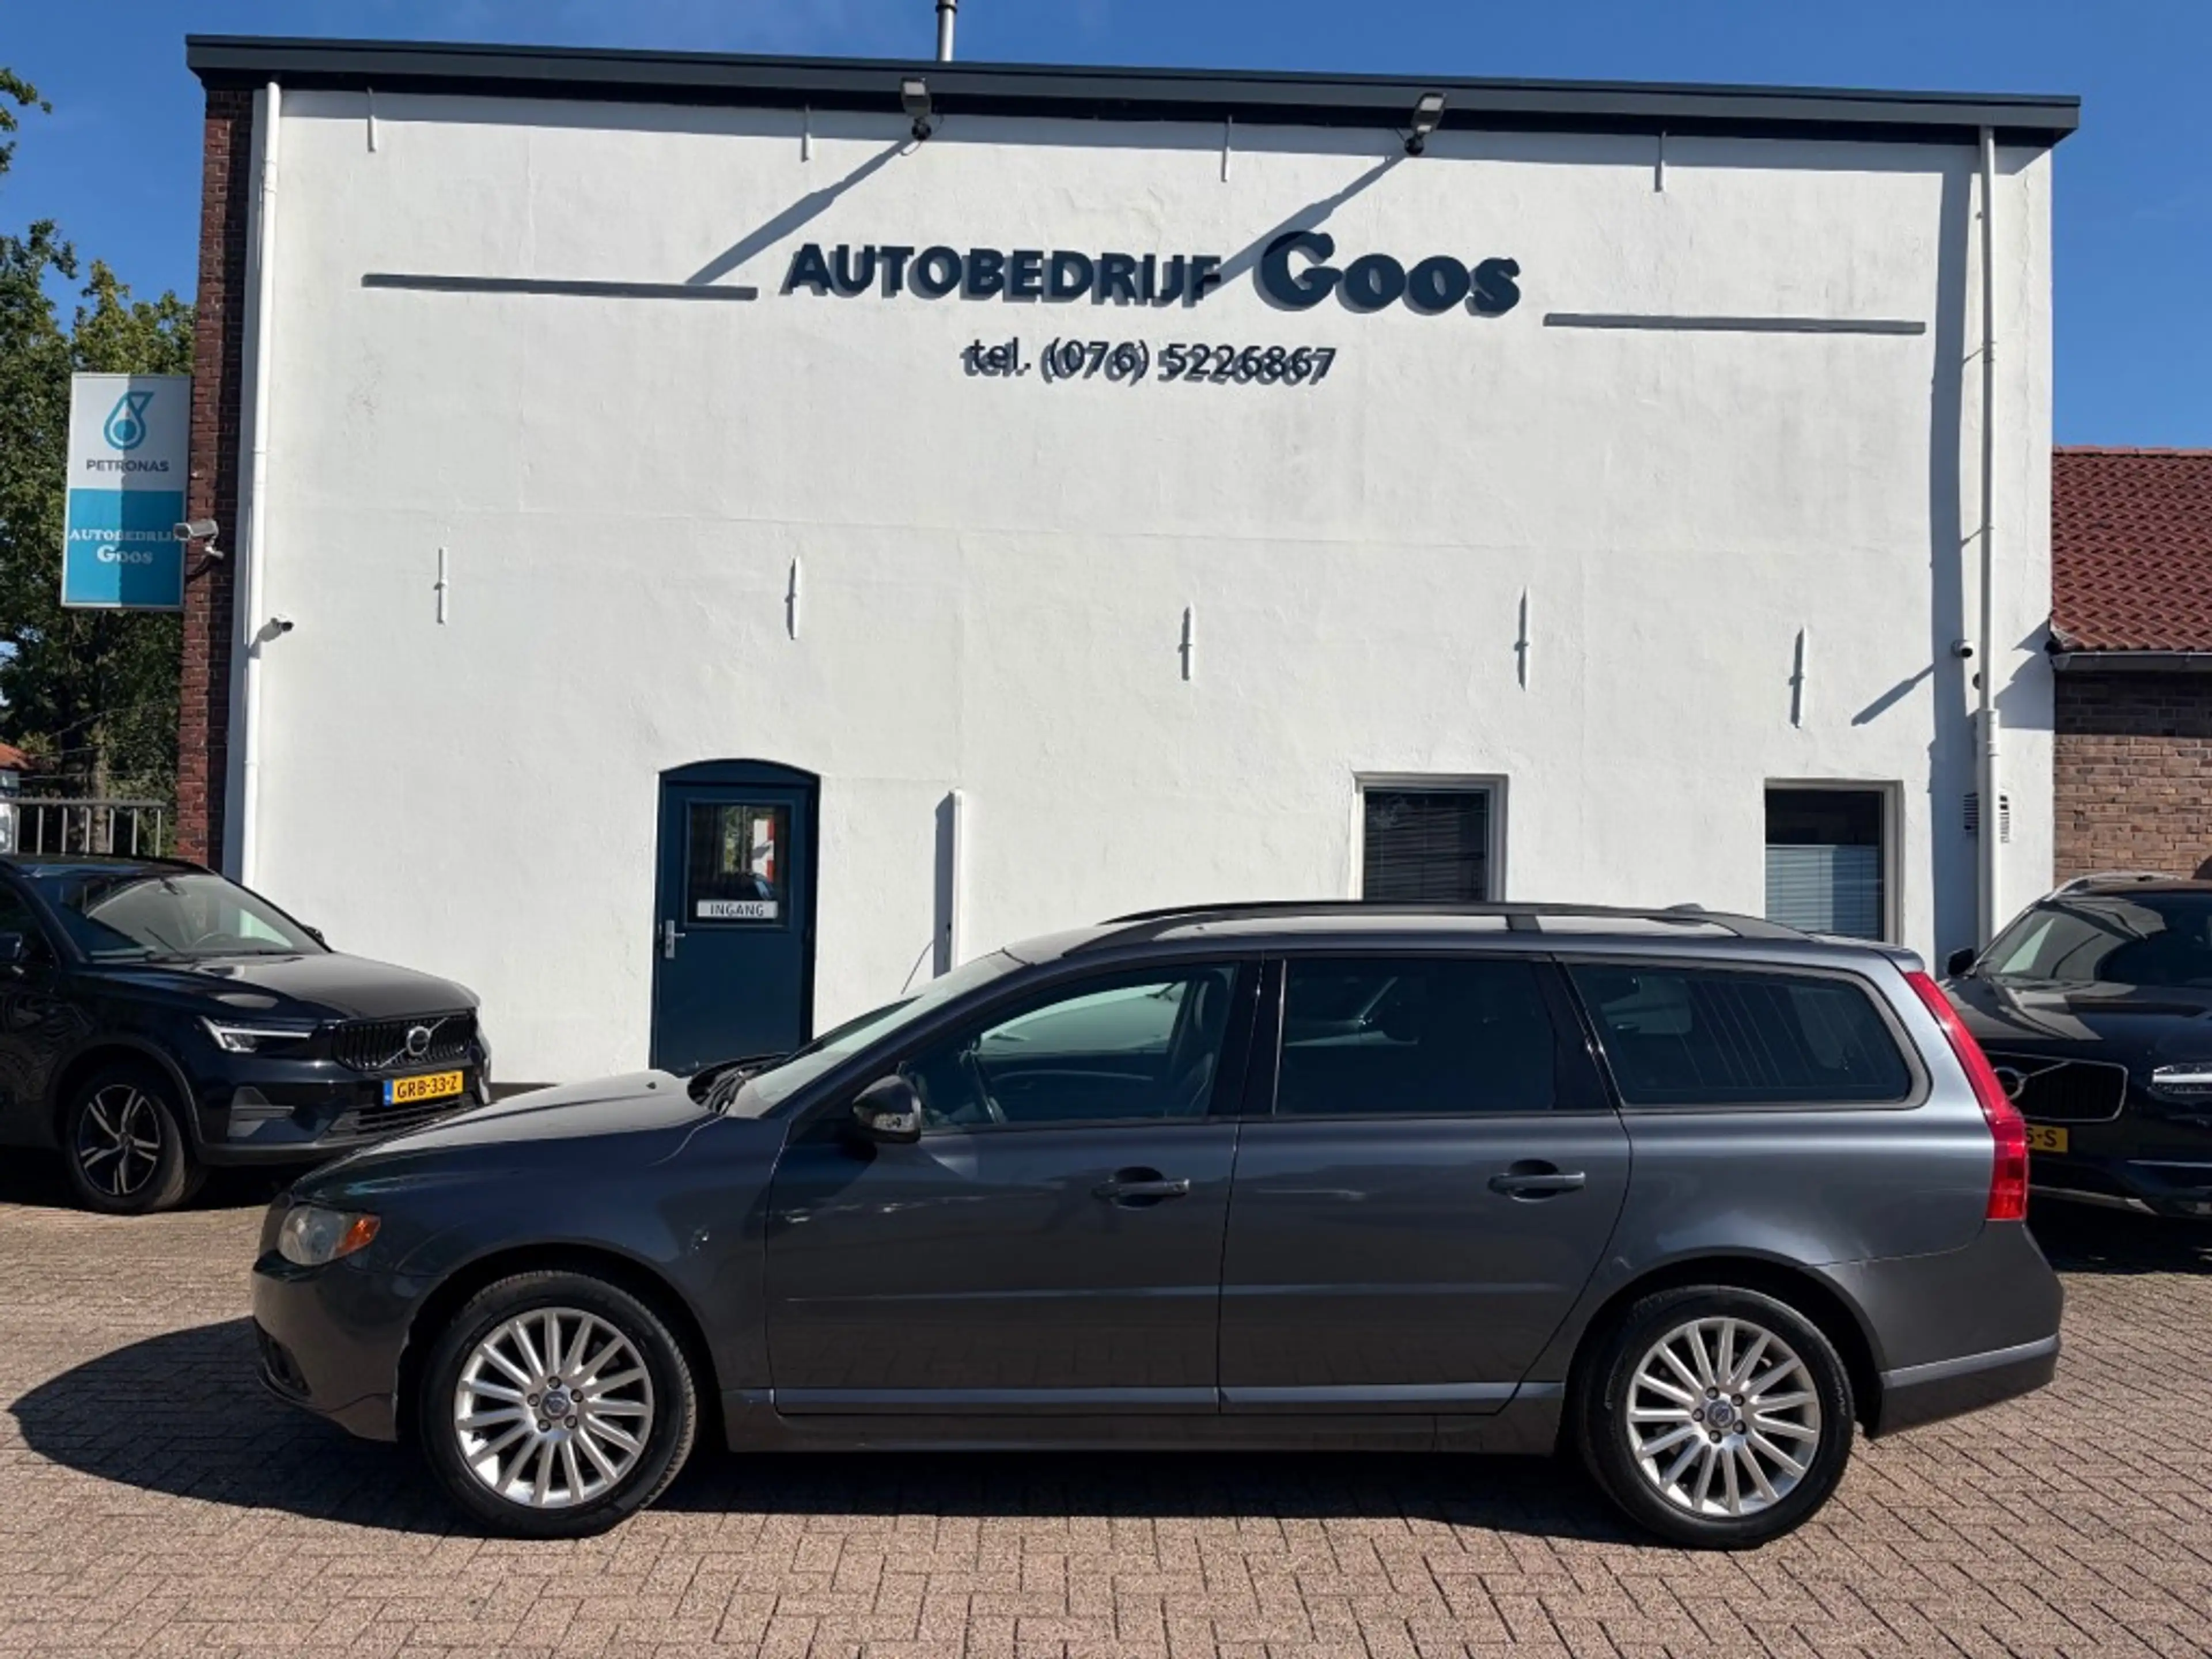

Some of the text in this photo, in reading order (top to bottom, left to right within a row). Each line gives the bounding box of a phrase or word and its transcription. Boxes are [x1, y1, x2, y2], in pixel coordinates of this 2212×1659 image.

[786, 243, 1221, 301] AUTOBEDRIJF
[969, 336, 1337, 379] tel. (076) 5226867
[86, 459, 169, 472] PETRONAS
[69, 529, 177, 542] AUTOBEDRIJ
[710, 903, 764, 917] INGANG
[397, 1074, 457, 1099] GRB-33-Z
